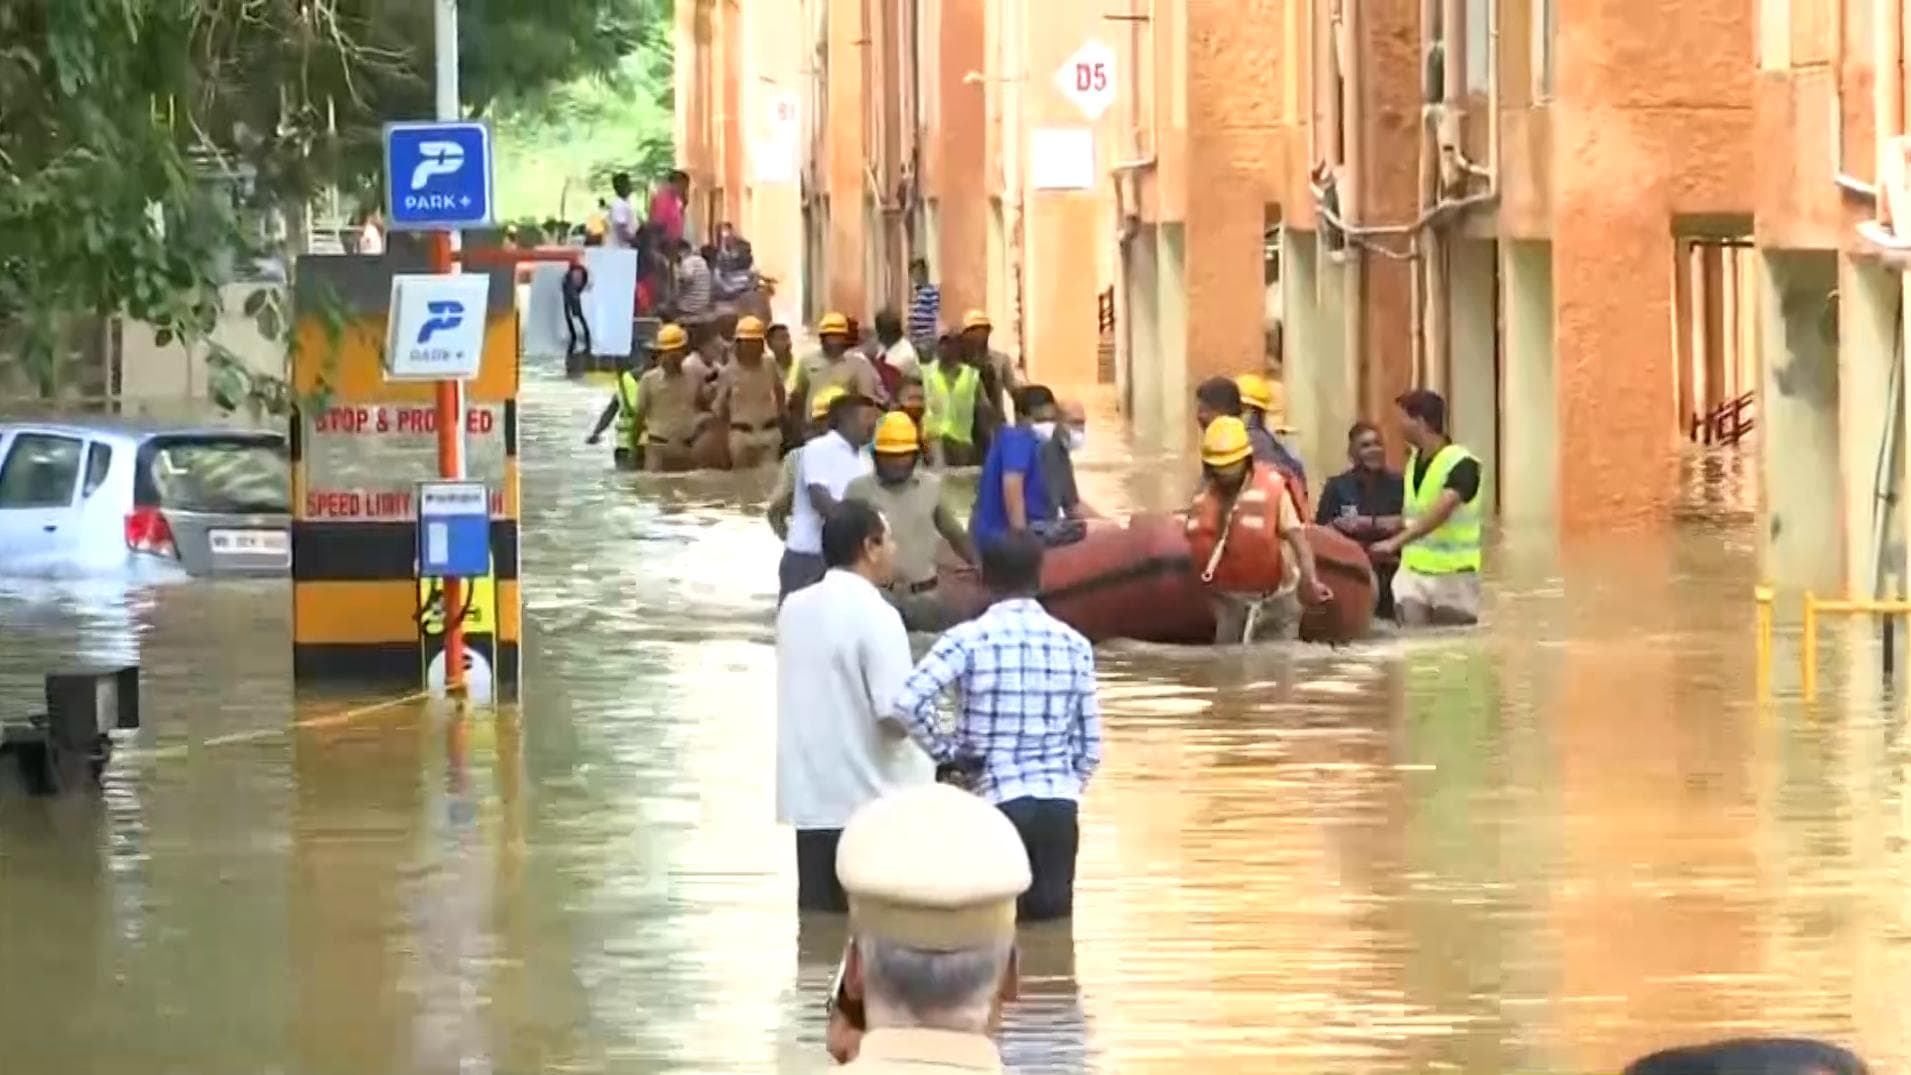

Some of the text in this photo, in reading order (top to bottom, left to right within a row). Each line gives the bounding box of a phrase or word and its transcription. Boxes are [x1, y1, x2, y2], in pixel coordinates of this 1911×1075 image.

[1076, 63, 1107, 91] D5
[375, 408, 389, 432] &
[396, 408, 493, 433] PROED
[307, 492, 360, 517] SPEED
